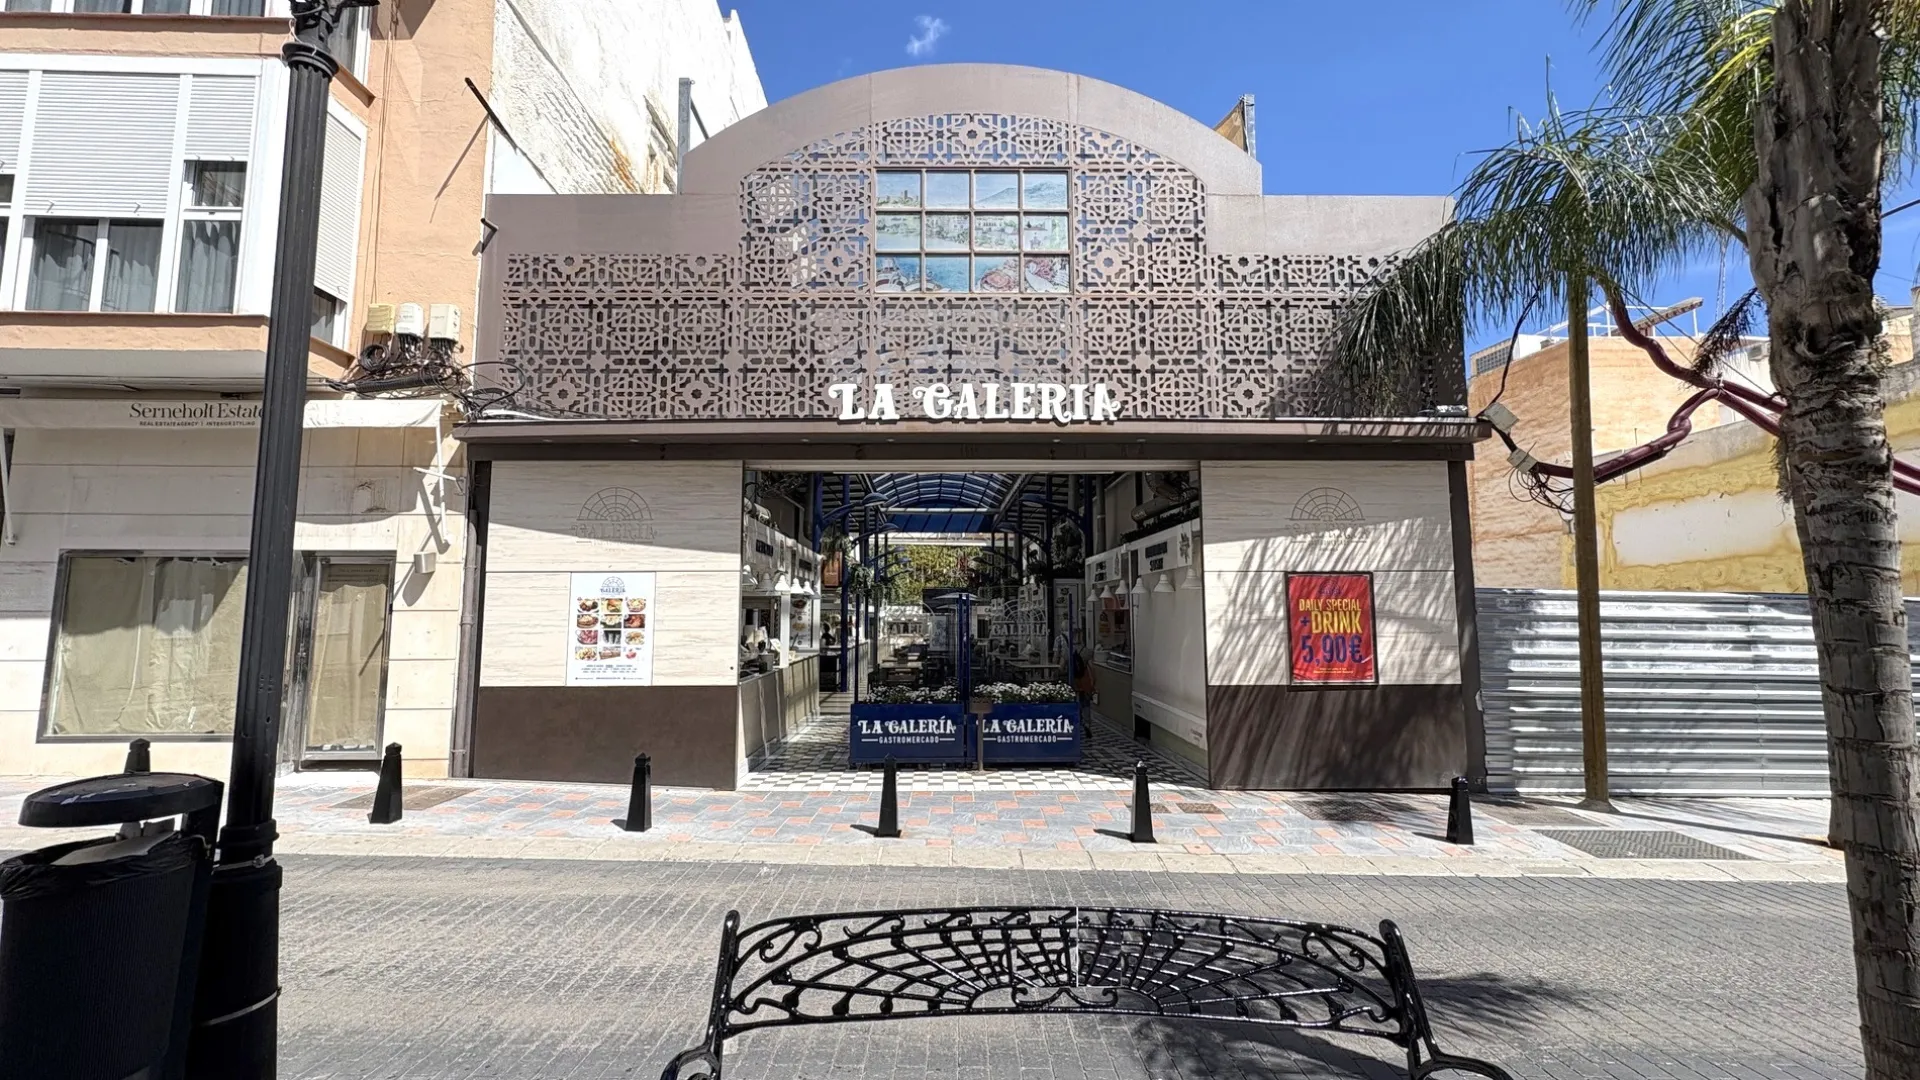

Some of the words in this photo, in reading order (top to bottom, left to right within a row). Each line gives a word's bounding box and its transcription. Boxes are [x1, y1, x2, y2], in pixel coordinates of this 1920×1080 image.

[129, 402, 214, 419] Serneholt
[828, 383, 900, 420] LA
[912, 382, 1121, 423] GALERIA
[1298, 598, 1324, 612] DAILY
[1326, 598, 1362, 612] SPECIAL
[858, 720, 883, 735] LA
[884, 715, 957, 735] GALERÍA
[1002, 714, 1075, 734] GALERÍA
[879, 735, 940, 745] GASTROMERCADO
[996, 735, 1058, 744] GASTROMERCADO
